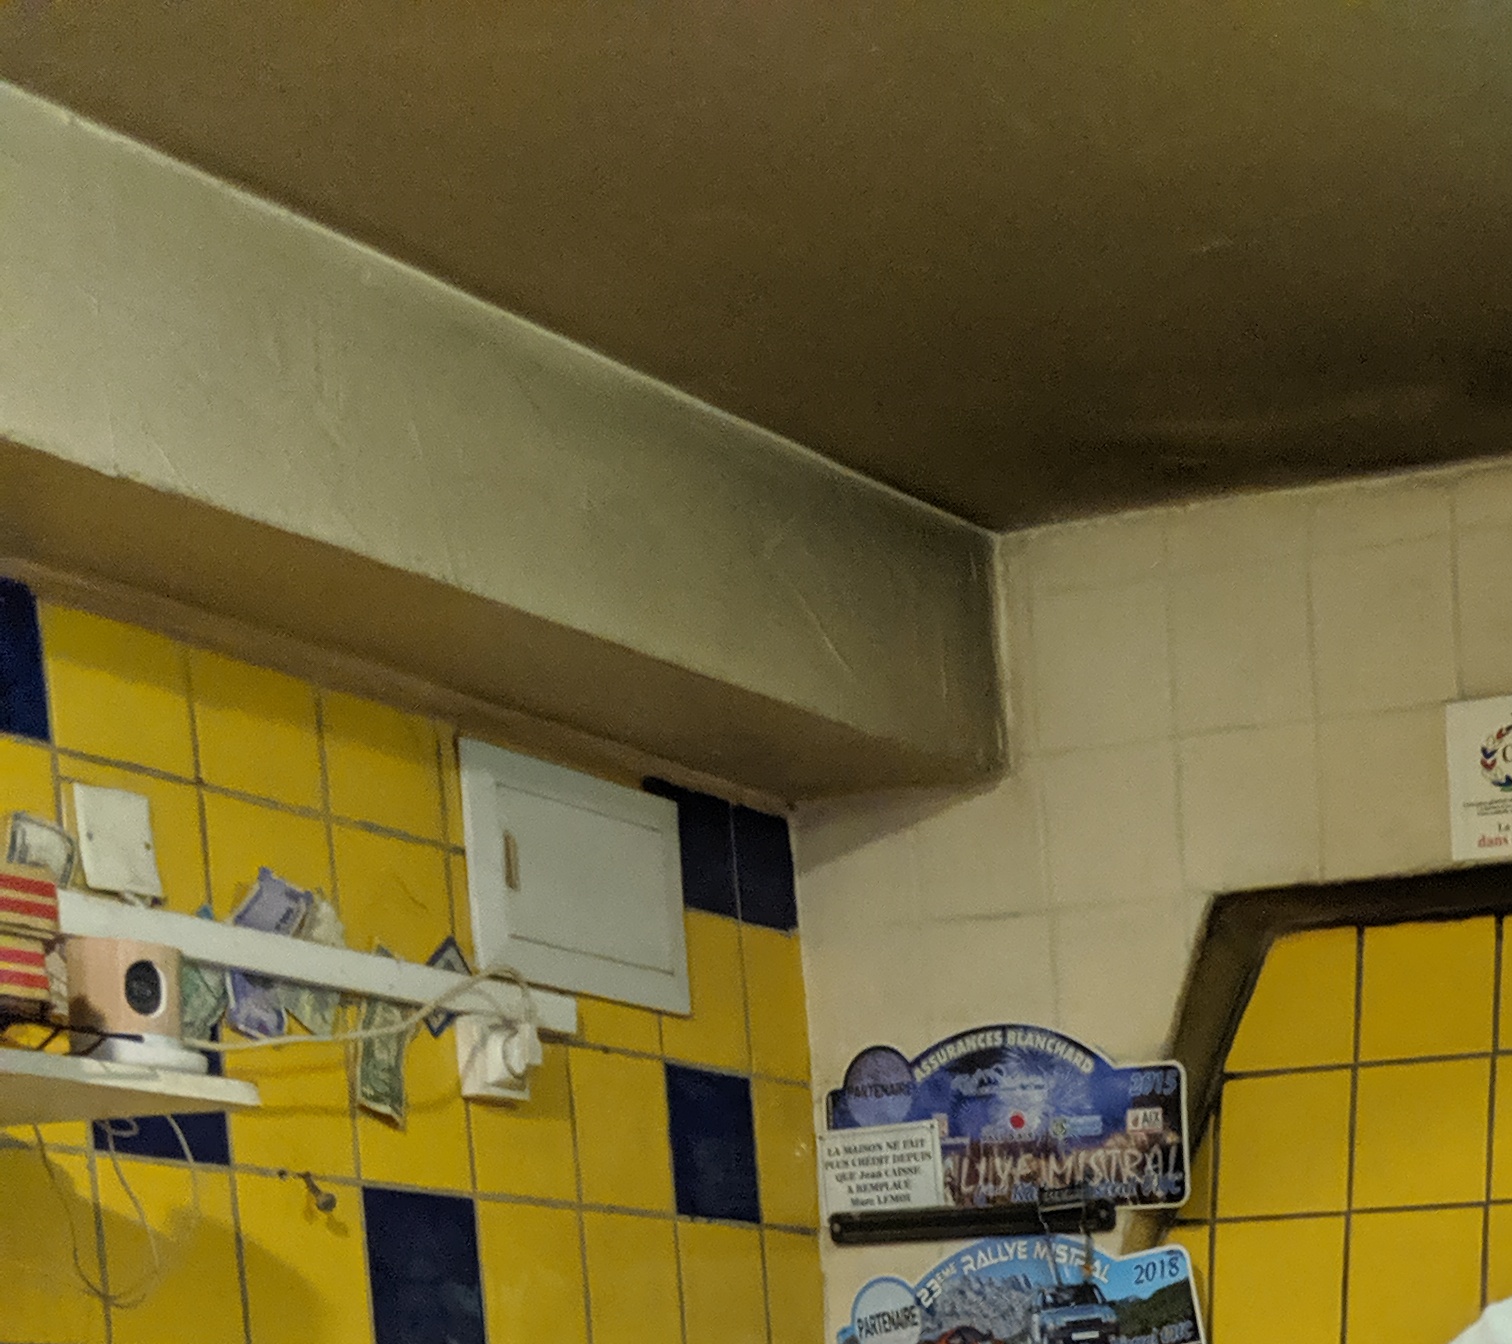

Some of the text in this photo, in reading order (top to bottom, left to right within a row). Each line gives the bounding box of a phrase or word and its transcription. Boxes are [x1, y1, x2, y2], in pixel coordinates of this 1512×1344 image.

[1477, 834, 1509, 849] dans
[912, 1030, 1003, 1083] ASSURANCES
[1007, 1029, 1095, 1075] BLANCHARD
[1043, 1143, 1180, 1188] MISTRAL
[960, 1239, 1028, 1276] RALLYE
[1133, 1256, 1180, 1286] 2018
[856, 1304, 919, 1339] PARTENAIRE
